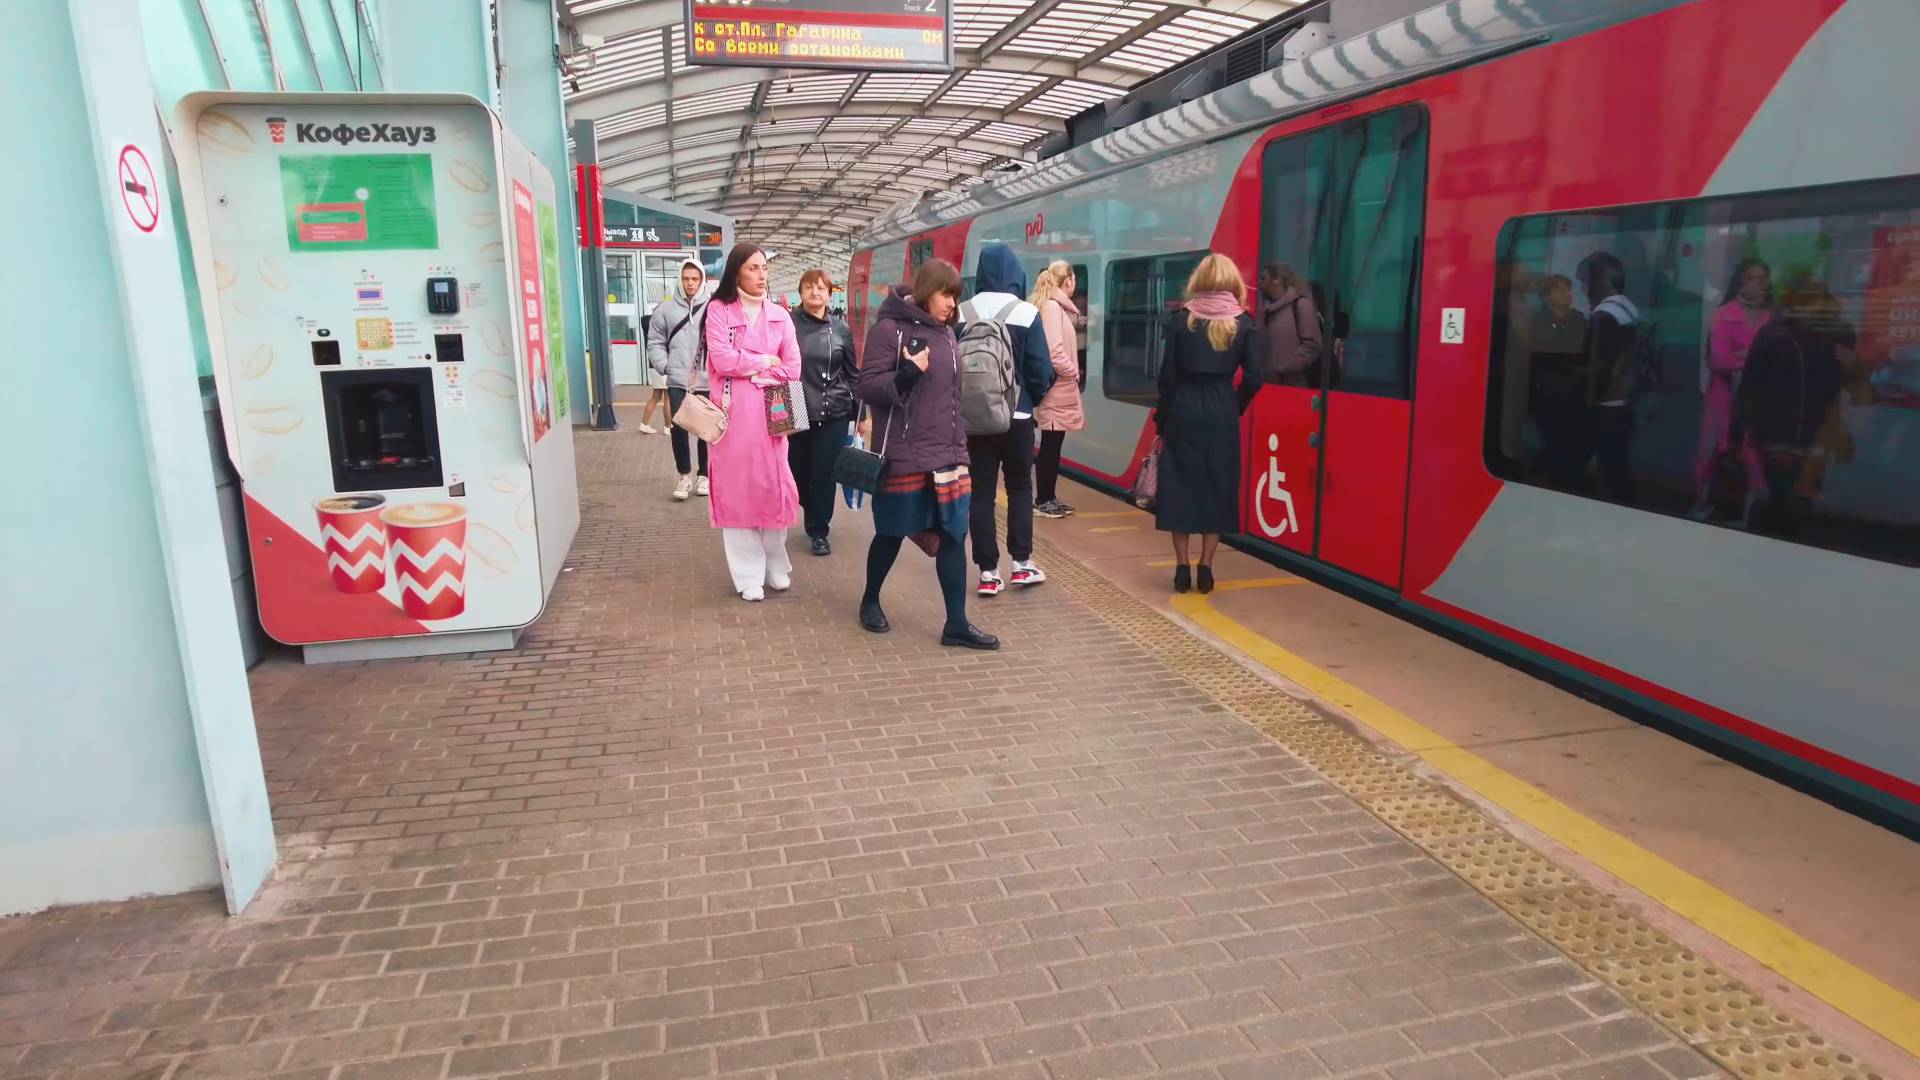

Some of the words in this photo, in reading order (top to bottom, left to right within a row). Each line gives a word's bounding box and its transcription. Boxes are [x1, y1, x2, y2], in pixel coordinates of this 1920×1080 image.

[925, 0, 936, 12] 2
[776, 23, 862, 40] Гагарина
[694, 37, 715, 52] Со
[725, 39, 779, 55] всеми
[789, 43, 904, 59] остановками
[296, 123, 437, 146] КофеХауз
